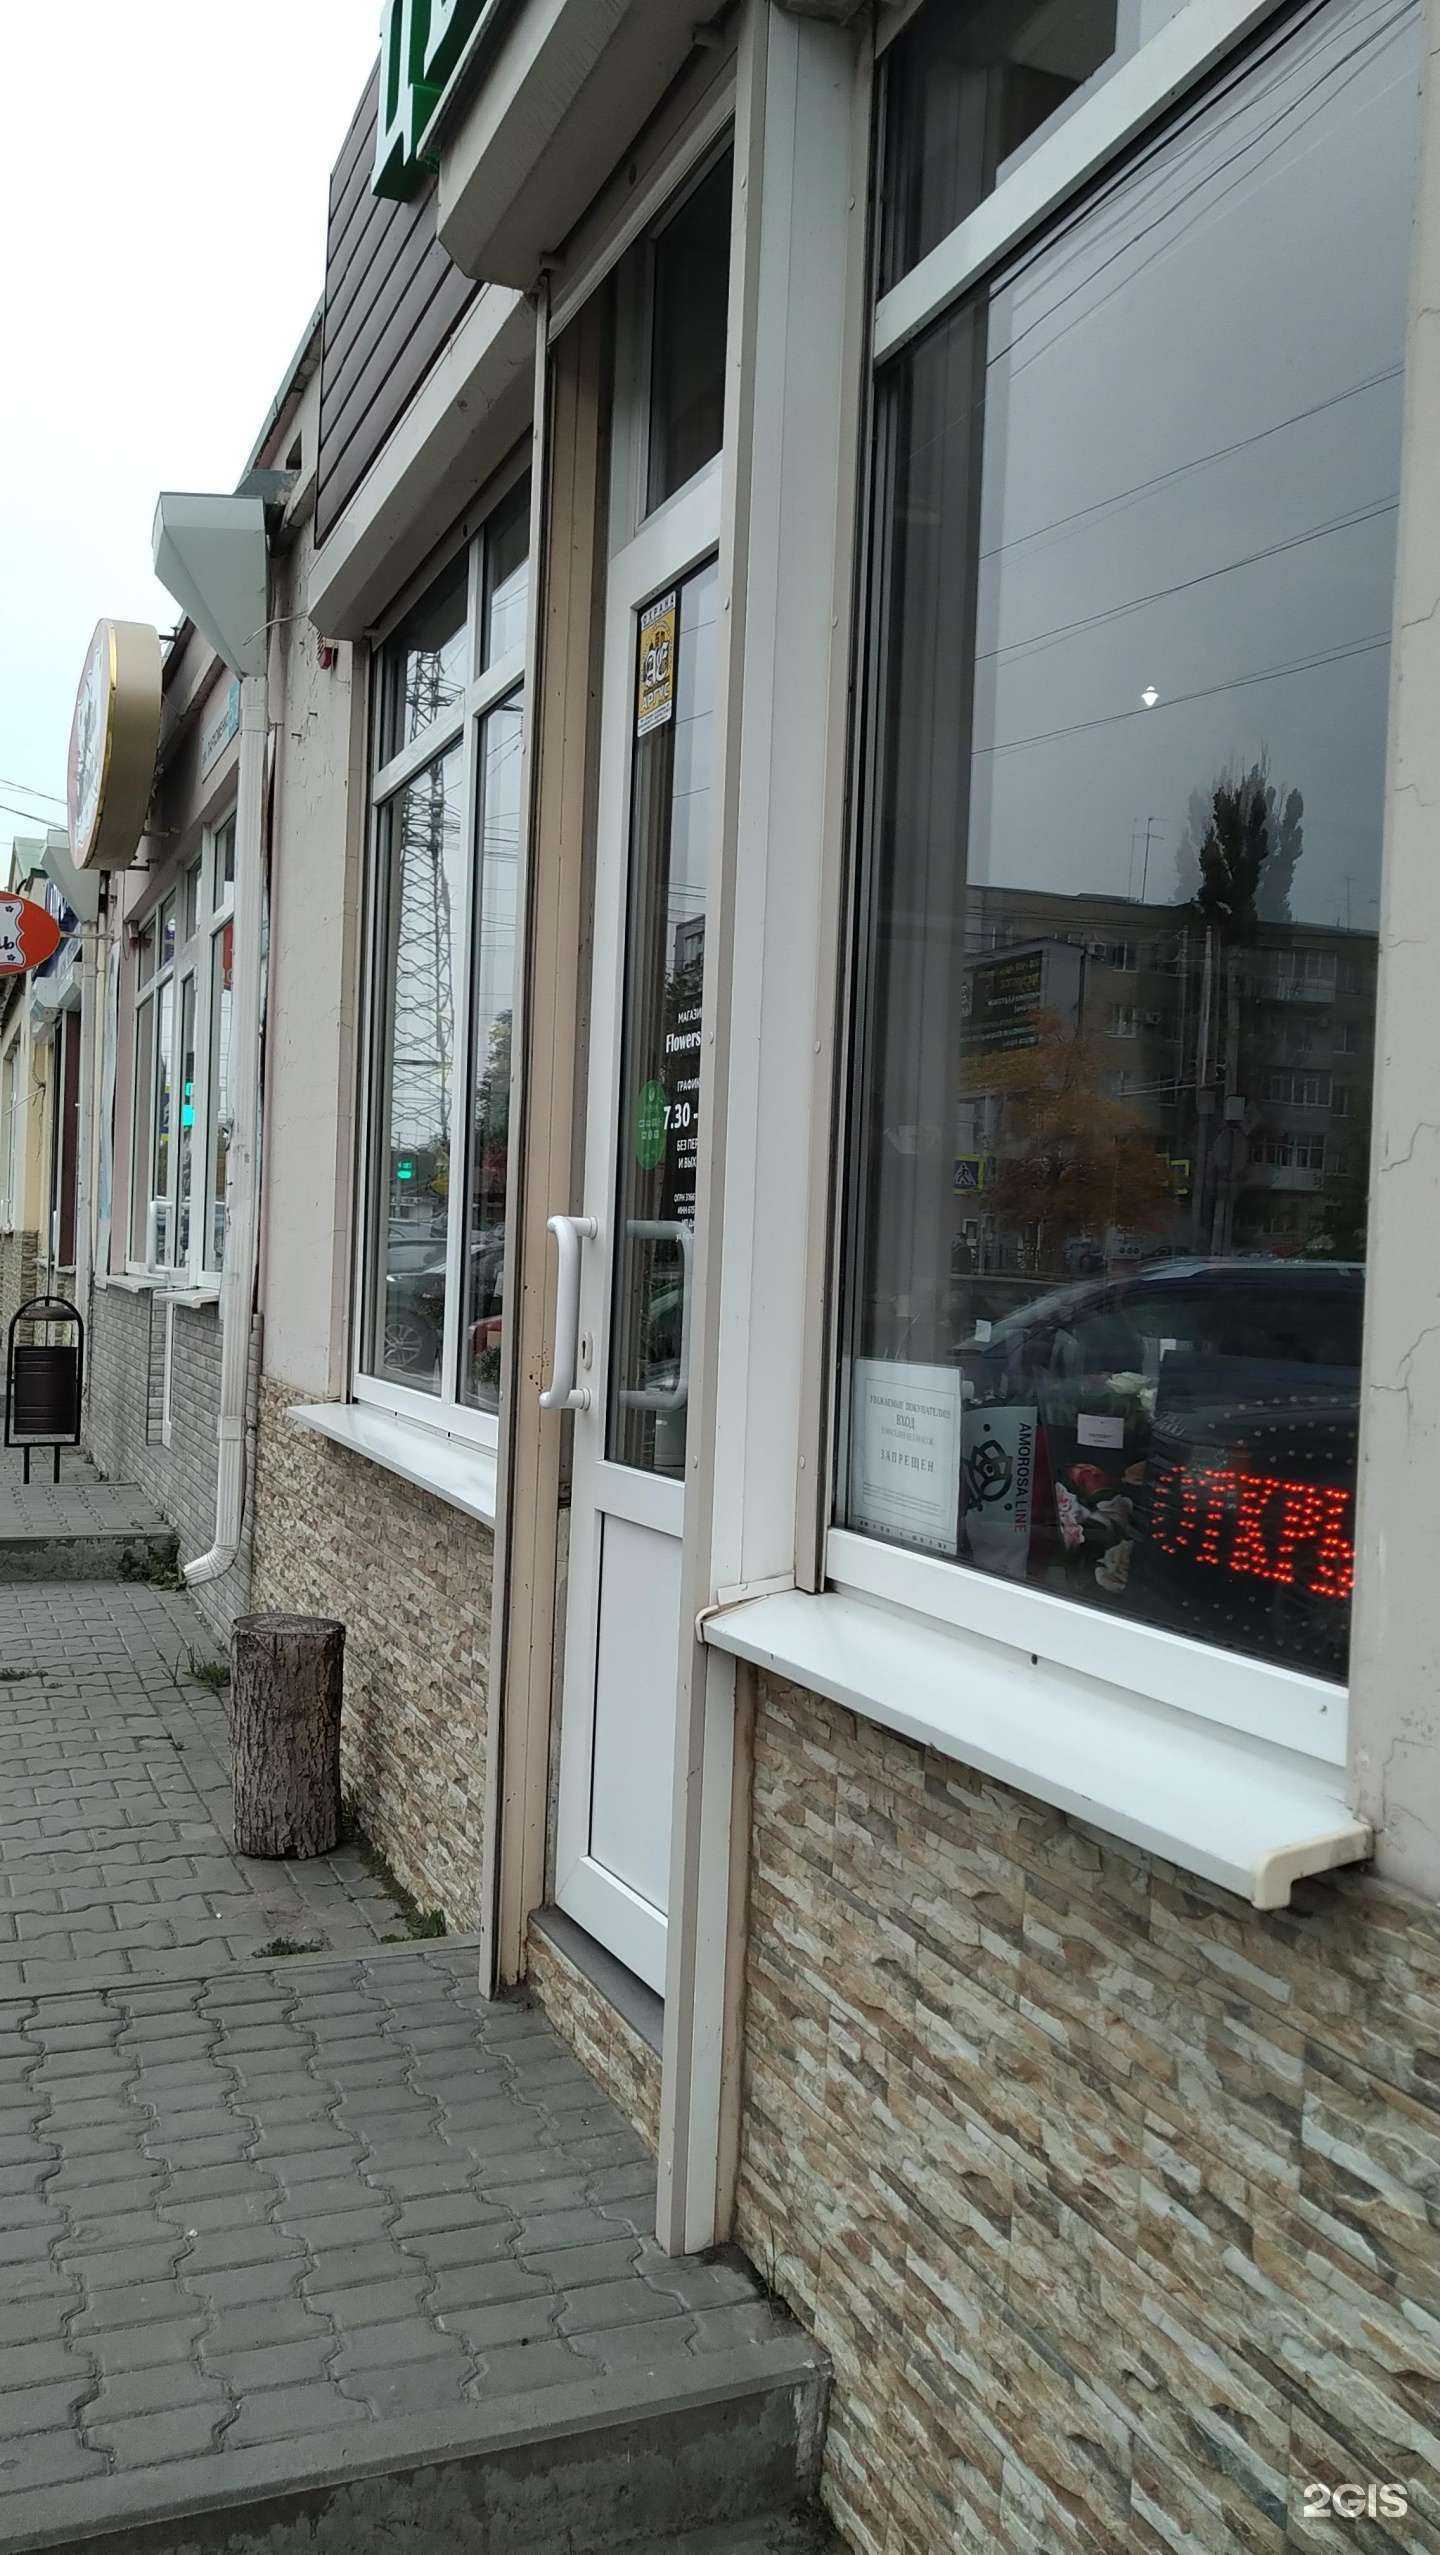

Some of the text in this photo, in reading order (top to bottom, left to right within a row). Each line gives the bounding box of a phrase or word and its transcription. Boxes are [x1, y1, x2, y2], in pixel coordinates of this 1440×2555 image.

[665, 1031, 701, 1054] Flowers
[663, 1102, 691, 1130] 7.30
[1013, 1422, 1033, 1533] AMOROSA LINE
